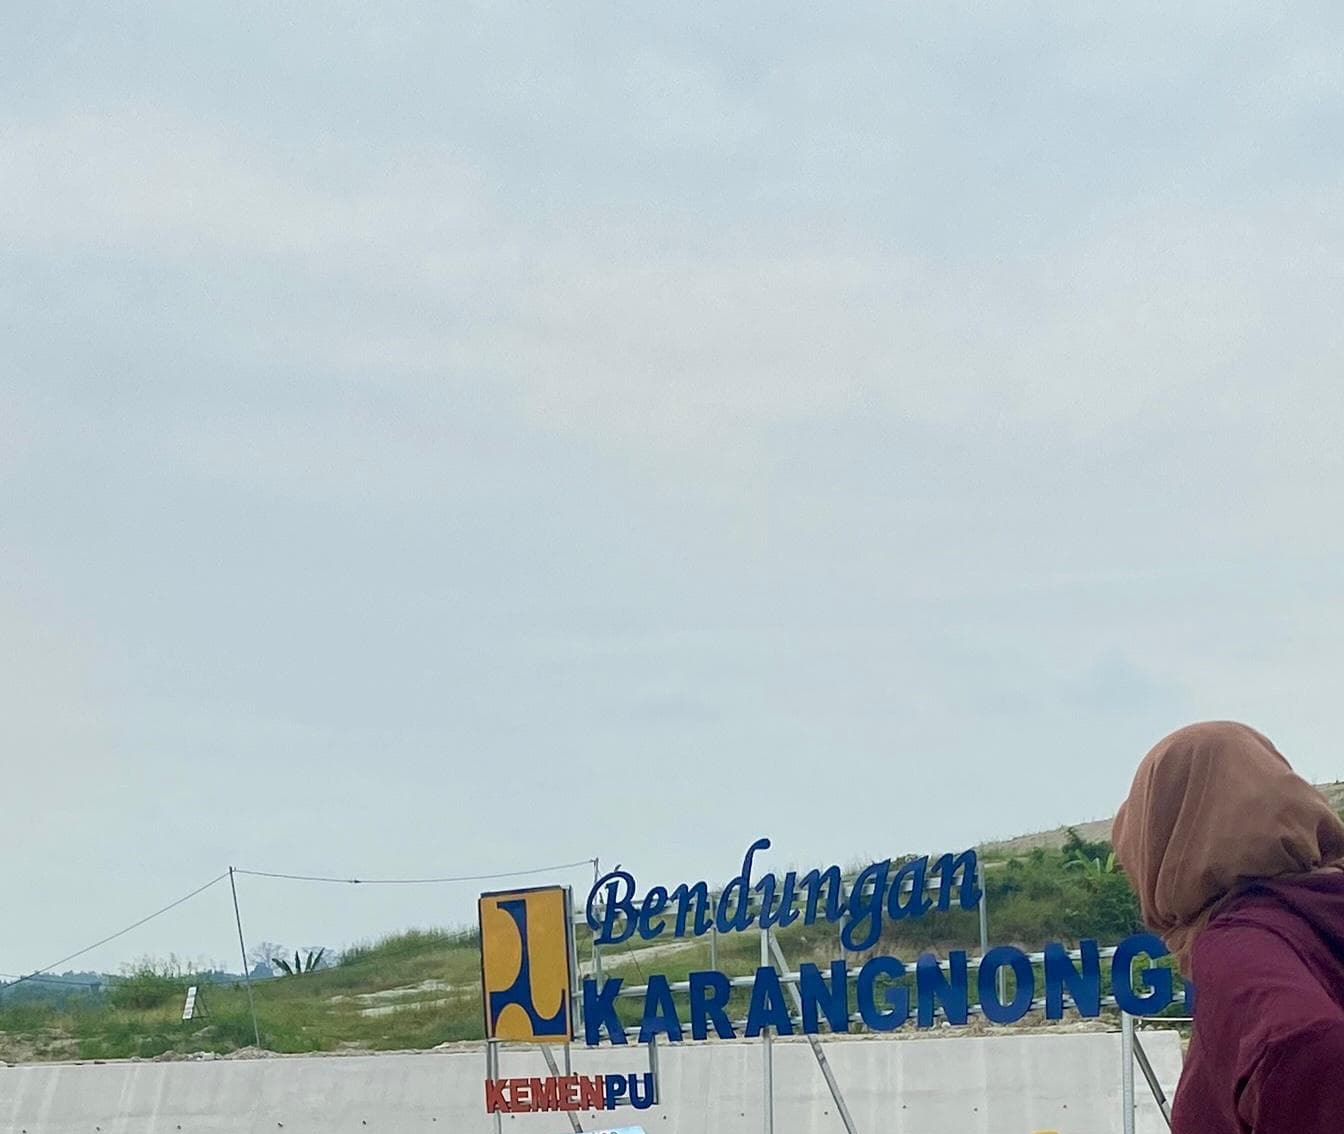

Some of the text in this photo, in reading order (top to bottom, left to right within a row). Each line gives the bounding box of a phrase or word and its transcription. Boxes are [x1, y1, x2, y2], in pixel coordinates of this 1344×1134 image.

[586, 838, 983, 952] Bendungan
[583, 933, 1196, 1046] KARANGNONG
[485, 1072, 654, 1114] KEMENPU
